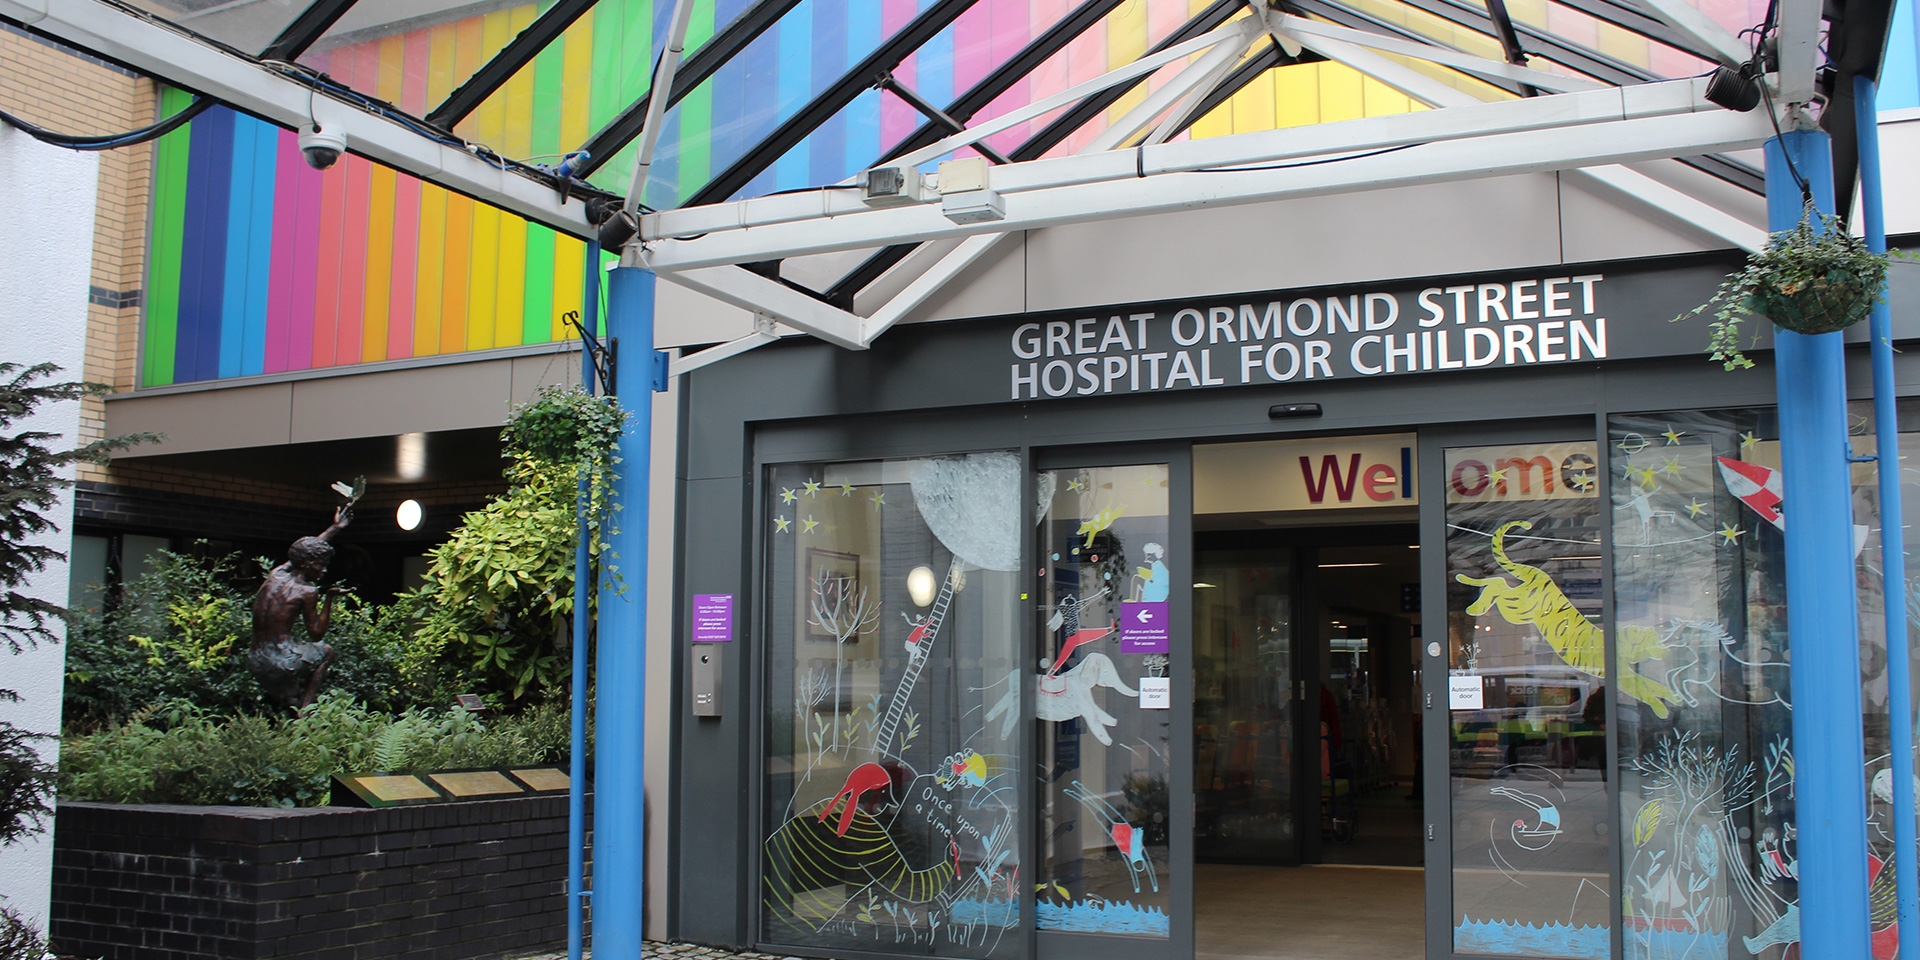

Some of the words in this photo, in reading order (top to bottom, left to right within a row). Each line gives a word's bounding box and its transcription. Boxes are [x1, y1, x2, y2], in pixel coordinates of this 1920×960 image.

[1011, 313, 1155, 359] GREAT
[1171, 292, 1399, 346] ORMOND
[1418, 274, 1604, 328] STREET
[1011, 349, 1224, 400] HOSPITAL
[1240, 340, 1334, 383] FOR
[1350, 318, 1607, 375] CHILDREN
[1299, 446, 1597, 504] Welome
[915, 803, 923, 814] a
[922, 787, 952, 814] Once
[956, 815, 980, 840] upon
